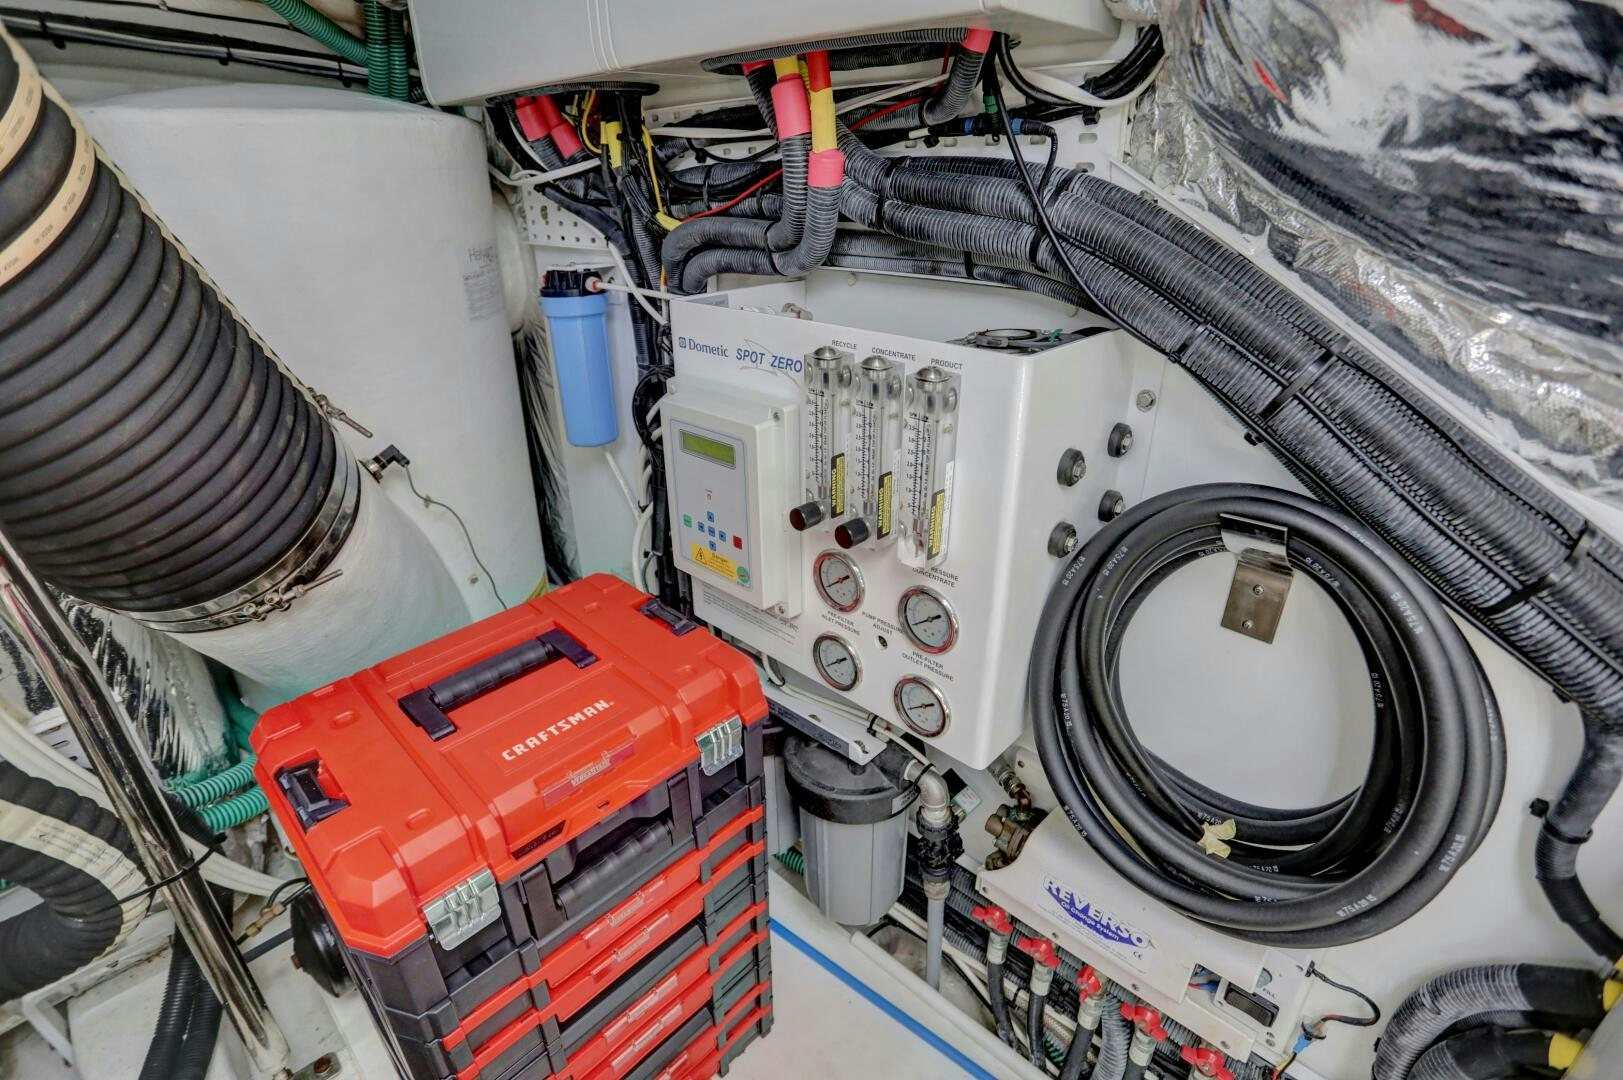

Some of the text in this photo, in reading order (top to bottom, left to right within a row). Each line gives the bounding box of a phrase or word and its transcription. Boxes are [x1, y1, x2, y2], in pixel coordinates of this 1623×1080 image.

[688, 338, 729, 358] Dometic
[831, 339, 857, 350] RECYCLE
[736, 348, 803, 373] SPOT ZERO
[871, 347, 916, 361] CONCENTRATE
[930, 358, 963, 370] PRODUCT
[928, 506, 936, 548] WARNING
[931, 567, 959, 582] RESSURE
[828, 610, 854, 627] PRE-FILTER
[862, 611, 876, 622] PUMP
[834, 620, 860, 636] PRESSURE
[872, 623, 893, 636] ADJUST
[902, 652, 954, 682] OUTLET PRESSURE
[912, 650, 944, 670] PRE-FILTER
[502, 700, 610, 760] CRAFTSMAN
[1043, 876, 1149, 948] REVERSO
[1061, 902, 1120, 942] Oil Change System
